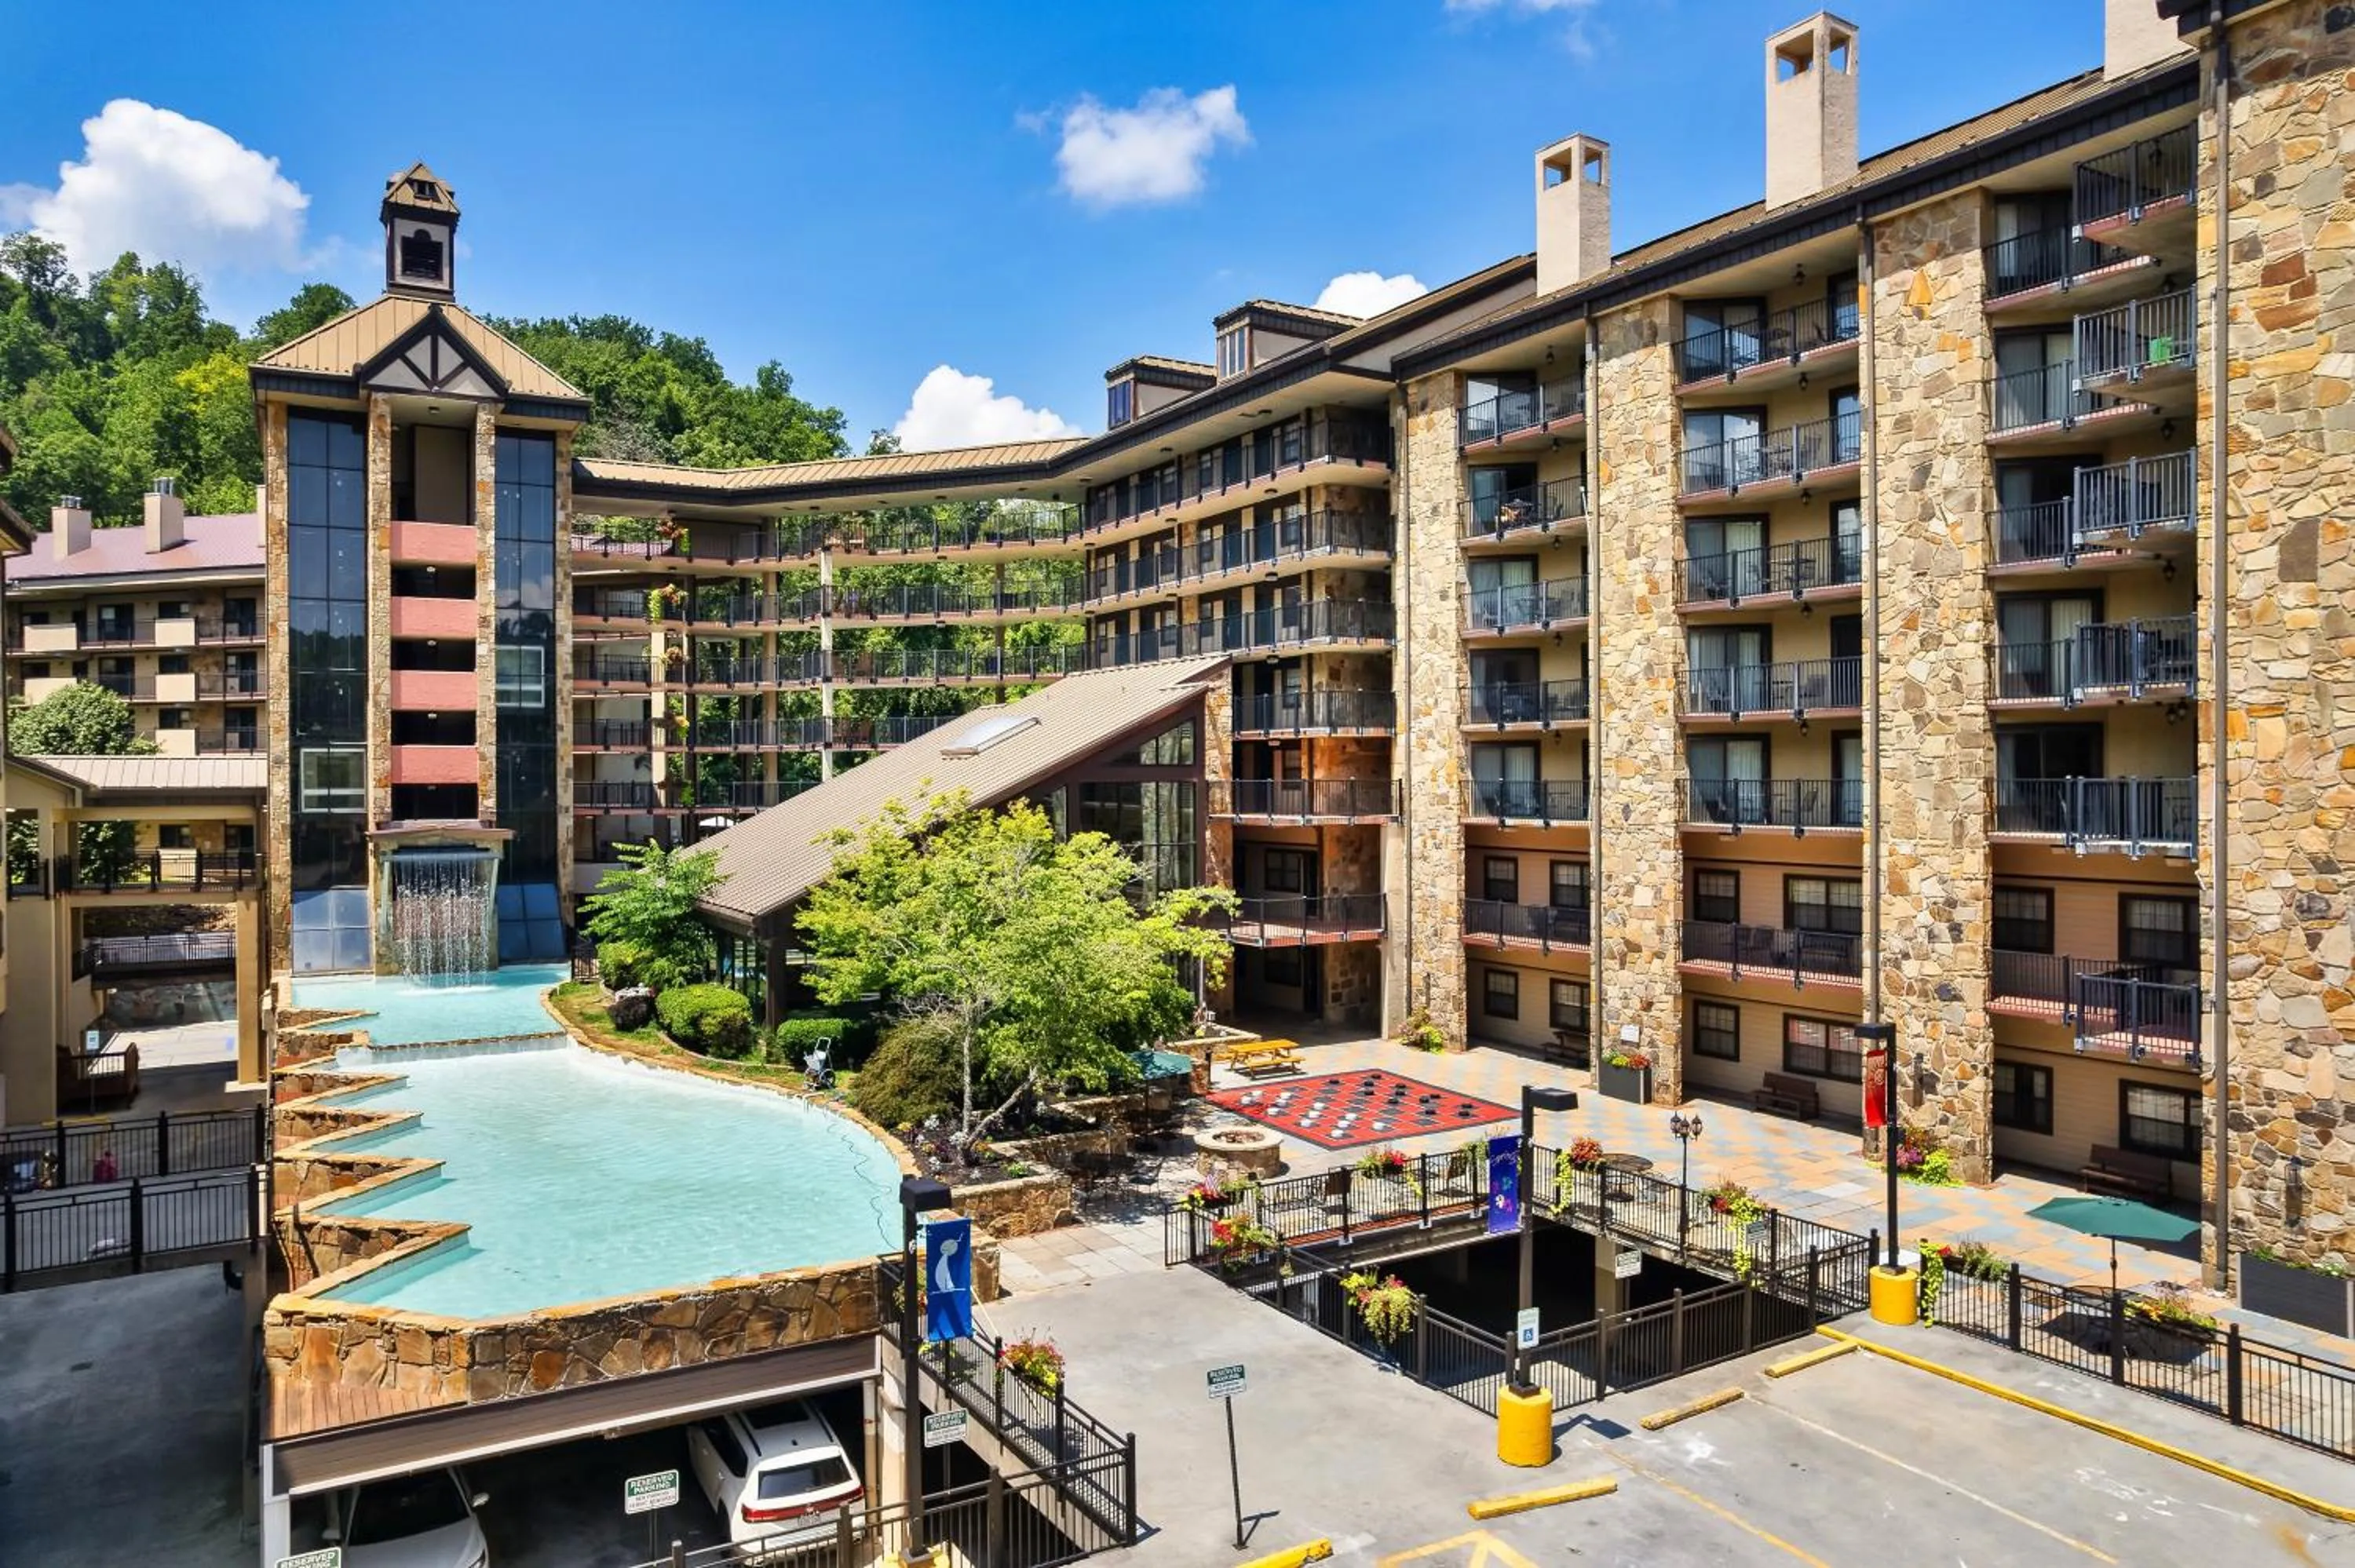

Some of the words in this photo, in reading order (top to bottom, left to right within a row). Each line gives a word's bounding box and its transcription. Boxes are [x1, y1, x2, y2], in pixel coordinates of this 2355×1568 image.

[1210, 1366, 1243, 1378] RESERVED
[1213, 1373, 1240, 1383] PARKING
[929, 1412, 965, 1424] RESERVED
[931, 1418, 962, 1429] PARKING
[630, 1473, 674, 1488] RESERVED
[633, 1481, 671, 1494] PARKING
[281, 1552, 335, 1568] RESERVED
